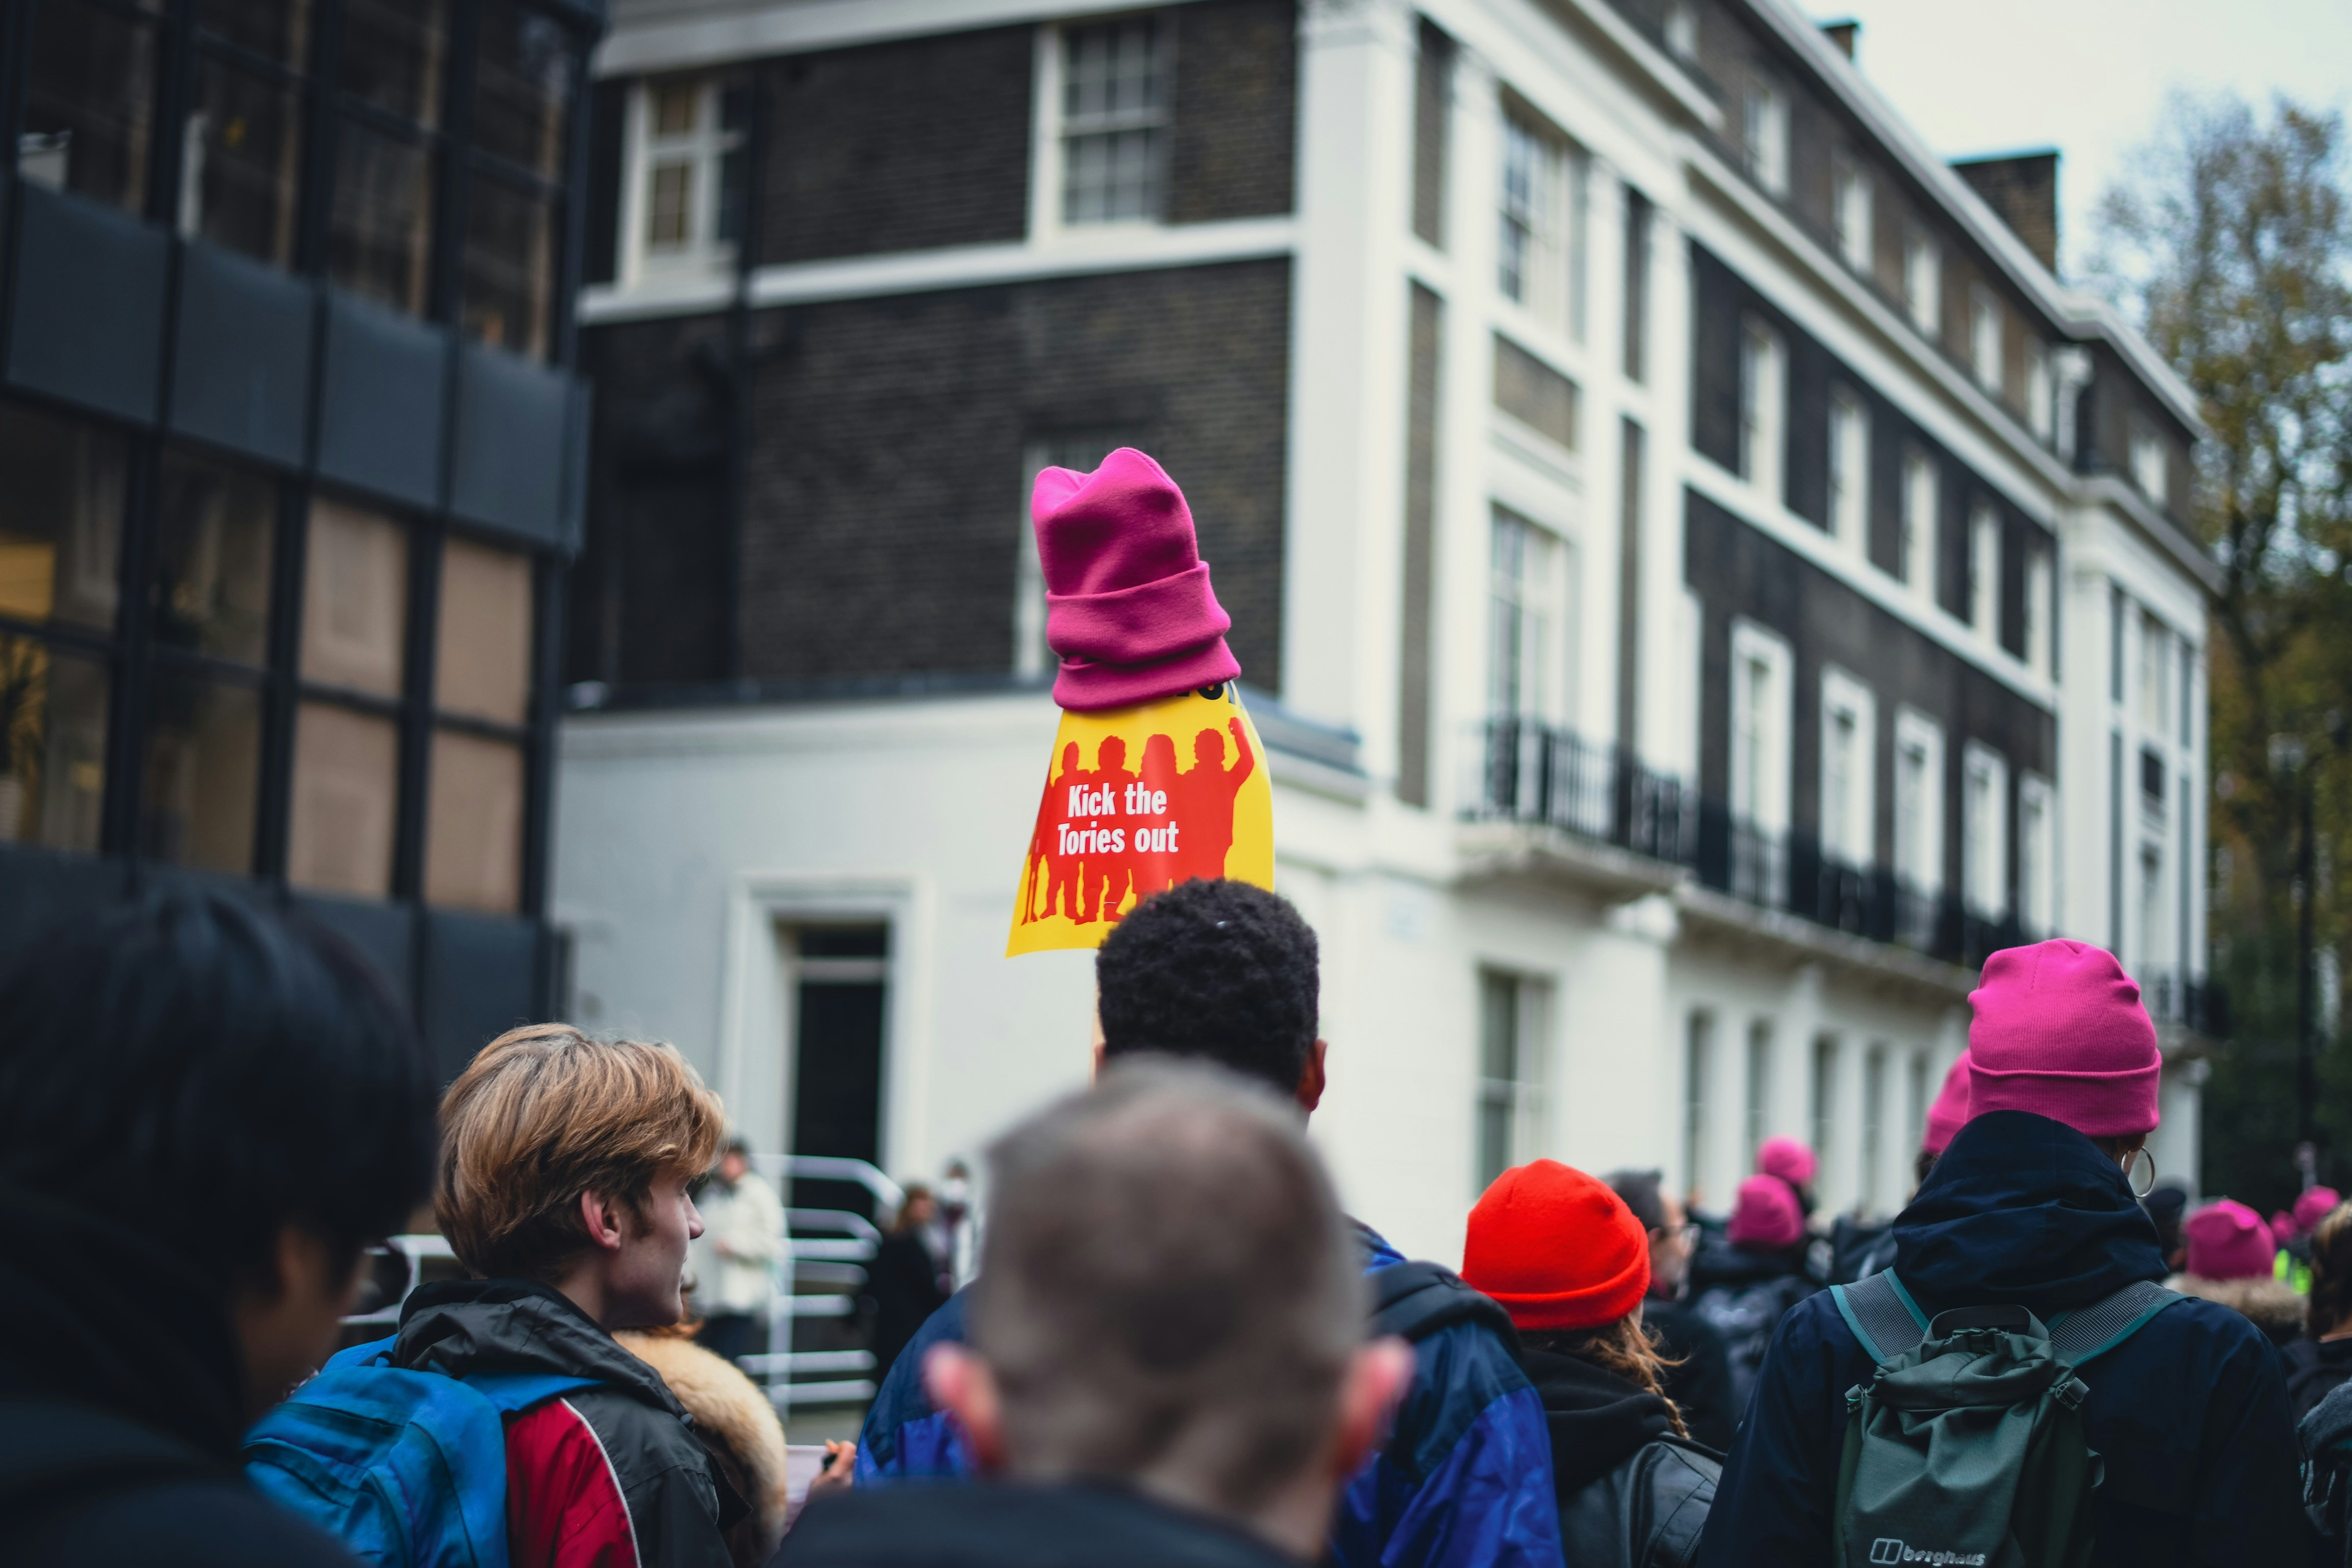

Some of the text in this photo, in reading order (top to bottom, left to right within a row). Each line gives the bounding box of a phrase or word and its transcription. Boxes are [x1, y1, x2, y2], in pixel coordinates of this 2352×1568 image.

[1068, 781, 1167, 818] Kick the
[1058, 820, 1180, 855] Tories out
[1903, 1545, 1986, 1566] berghaus
